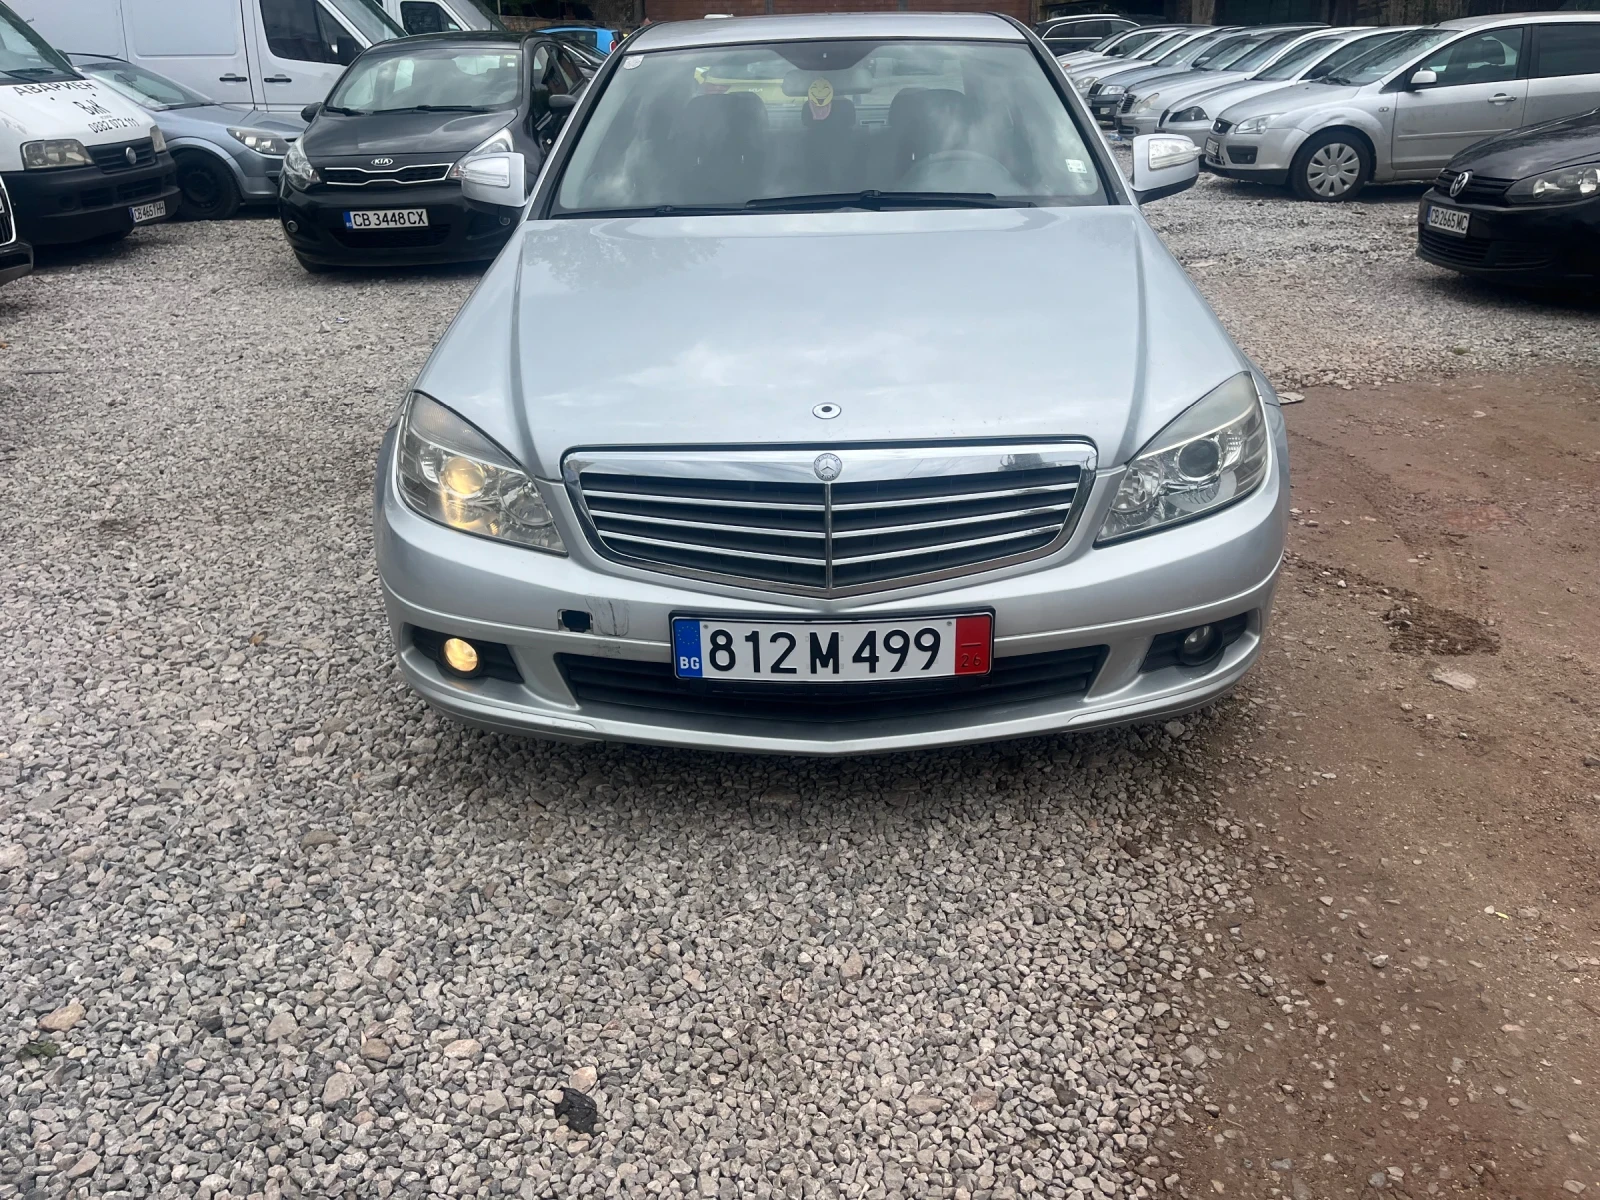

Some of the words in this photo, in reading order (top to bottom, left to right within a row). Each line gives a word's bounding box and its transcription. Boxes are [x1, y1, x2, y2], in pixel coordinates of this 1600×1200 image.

[12, 81, 99, 96] АВАРИЕН
[353, 212, 371, 227] CB
[373, 212, 406, 227] 3448
[407, 211, 426, 225] CX
[709, 629, 797, 674] 812
[809, 631, 840, 675] M
[852, 627, 942, 673] 499
[679, 656, 700, 670] BG
[961, 652, 982, 668] 26
